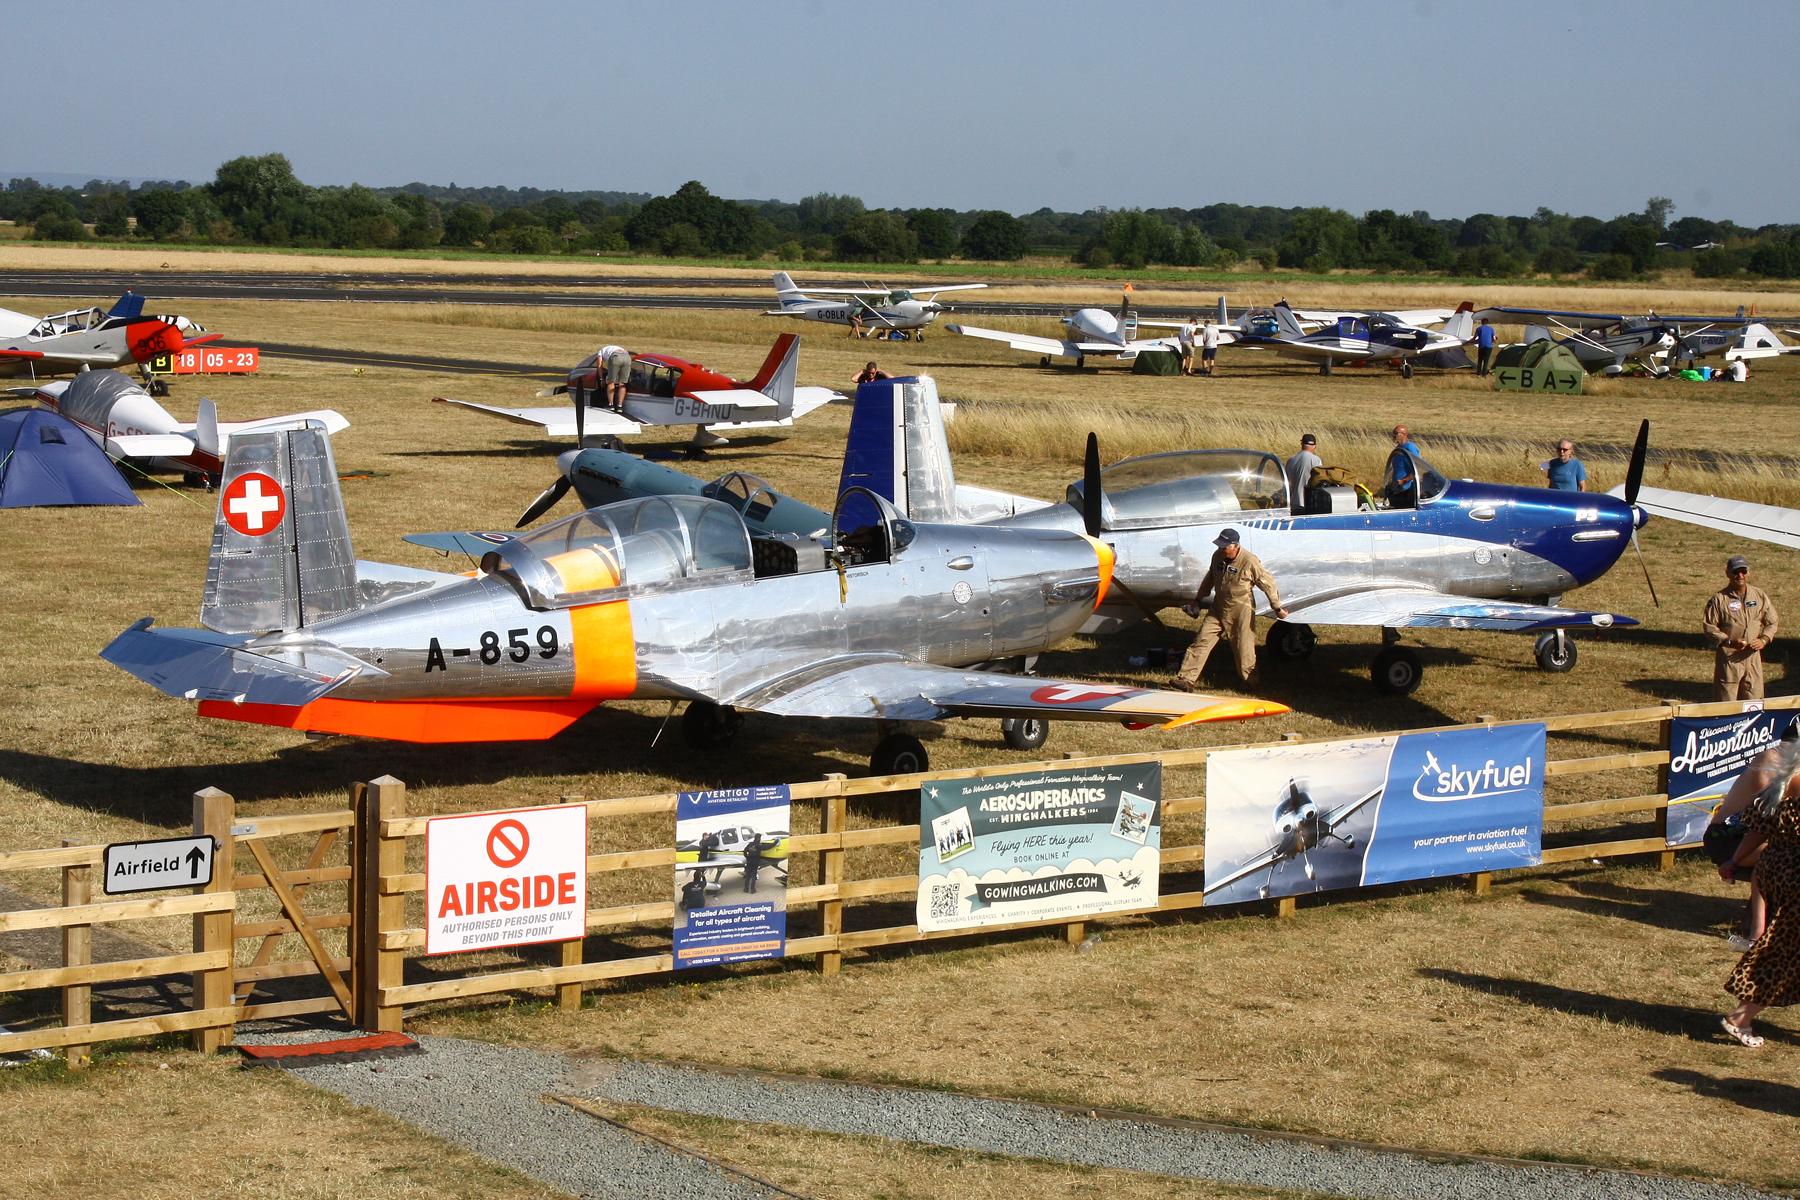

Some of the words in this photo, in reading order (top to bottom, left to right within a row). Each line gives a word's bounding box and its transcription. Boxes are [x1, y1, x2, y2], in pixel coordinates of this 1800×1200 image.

[817, 310, 846, 320] G-OBLR
[179, 354, 195, 367] 18
[207, 354, 224, 367] 05
[236, 353, 254, 367] 23
[1520, 369, 1534, 388] B
[1542, 370, 1556, 389] A
[424, 625, 559, 673] A-859
[1671, 718, 1775, 773] Adventure!
[995, 782, 1009, 792] Only
[1436, 757, 1531, 798] skyfuel
[706, 788, 750, 799] VERTIGO
[979, 787, 1106, 812] AEROSUPERBATICS
[1001, 807, 1087, 824] WINGWALKERS
[990, 840, 1021, 856] Flying
[1022, 834, 1048, 848] HERE
[1049, 834, 1066, 845] this
[1068, 833, 1094, 849] year!
[1413, 836, 1434, 848] your
[1434, 834, 1467, 847] partner
[1468, 832, 1475, 840] in
[1476, 828, 1510, 839] aviation
[1510, 826, 1528, 836] fuel
[1466, 839, 1526, 853] www.skyfuel.co.uk
[114, 856, 180, 877] Airfield
[1013, 855, 1032, 863] BOOK
[1035, 852, 1060, 861] ONLINE
[1061, 851, 1070, 859] AT
[438, 872, 577, 918] AIRSIDE
[984, 876, 1098, 899] GOWINGWALKING.COM
[690, 910, 717, 918] Detailed
[718, 907, 743, 916] Aircraft
[744, 905, 772, 914] Cleaning
[706, 918, 714, 926] all
[714, 917, 733, 926] types
[741, 914, 766, 922] aircraft
[442, 918, 502, 935] AUTHORISED
[504, 913, 547, 927] PERSONS
[549, 911, 573, 922] ONLY
[462, 931, 499, 945] BEYOND
[501, 928, 523, 940] THIS
[525, 926, 554, 938] POINT
